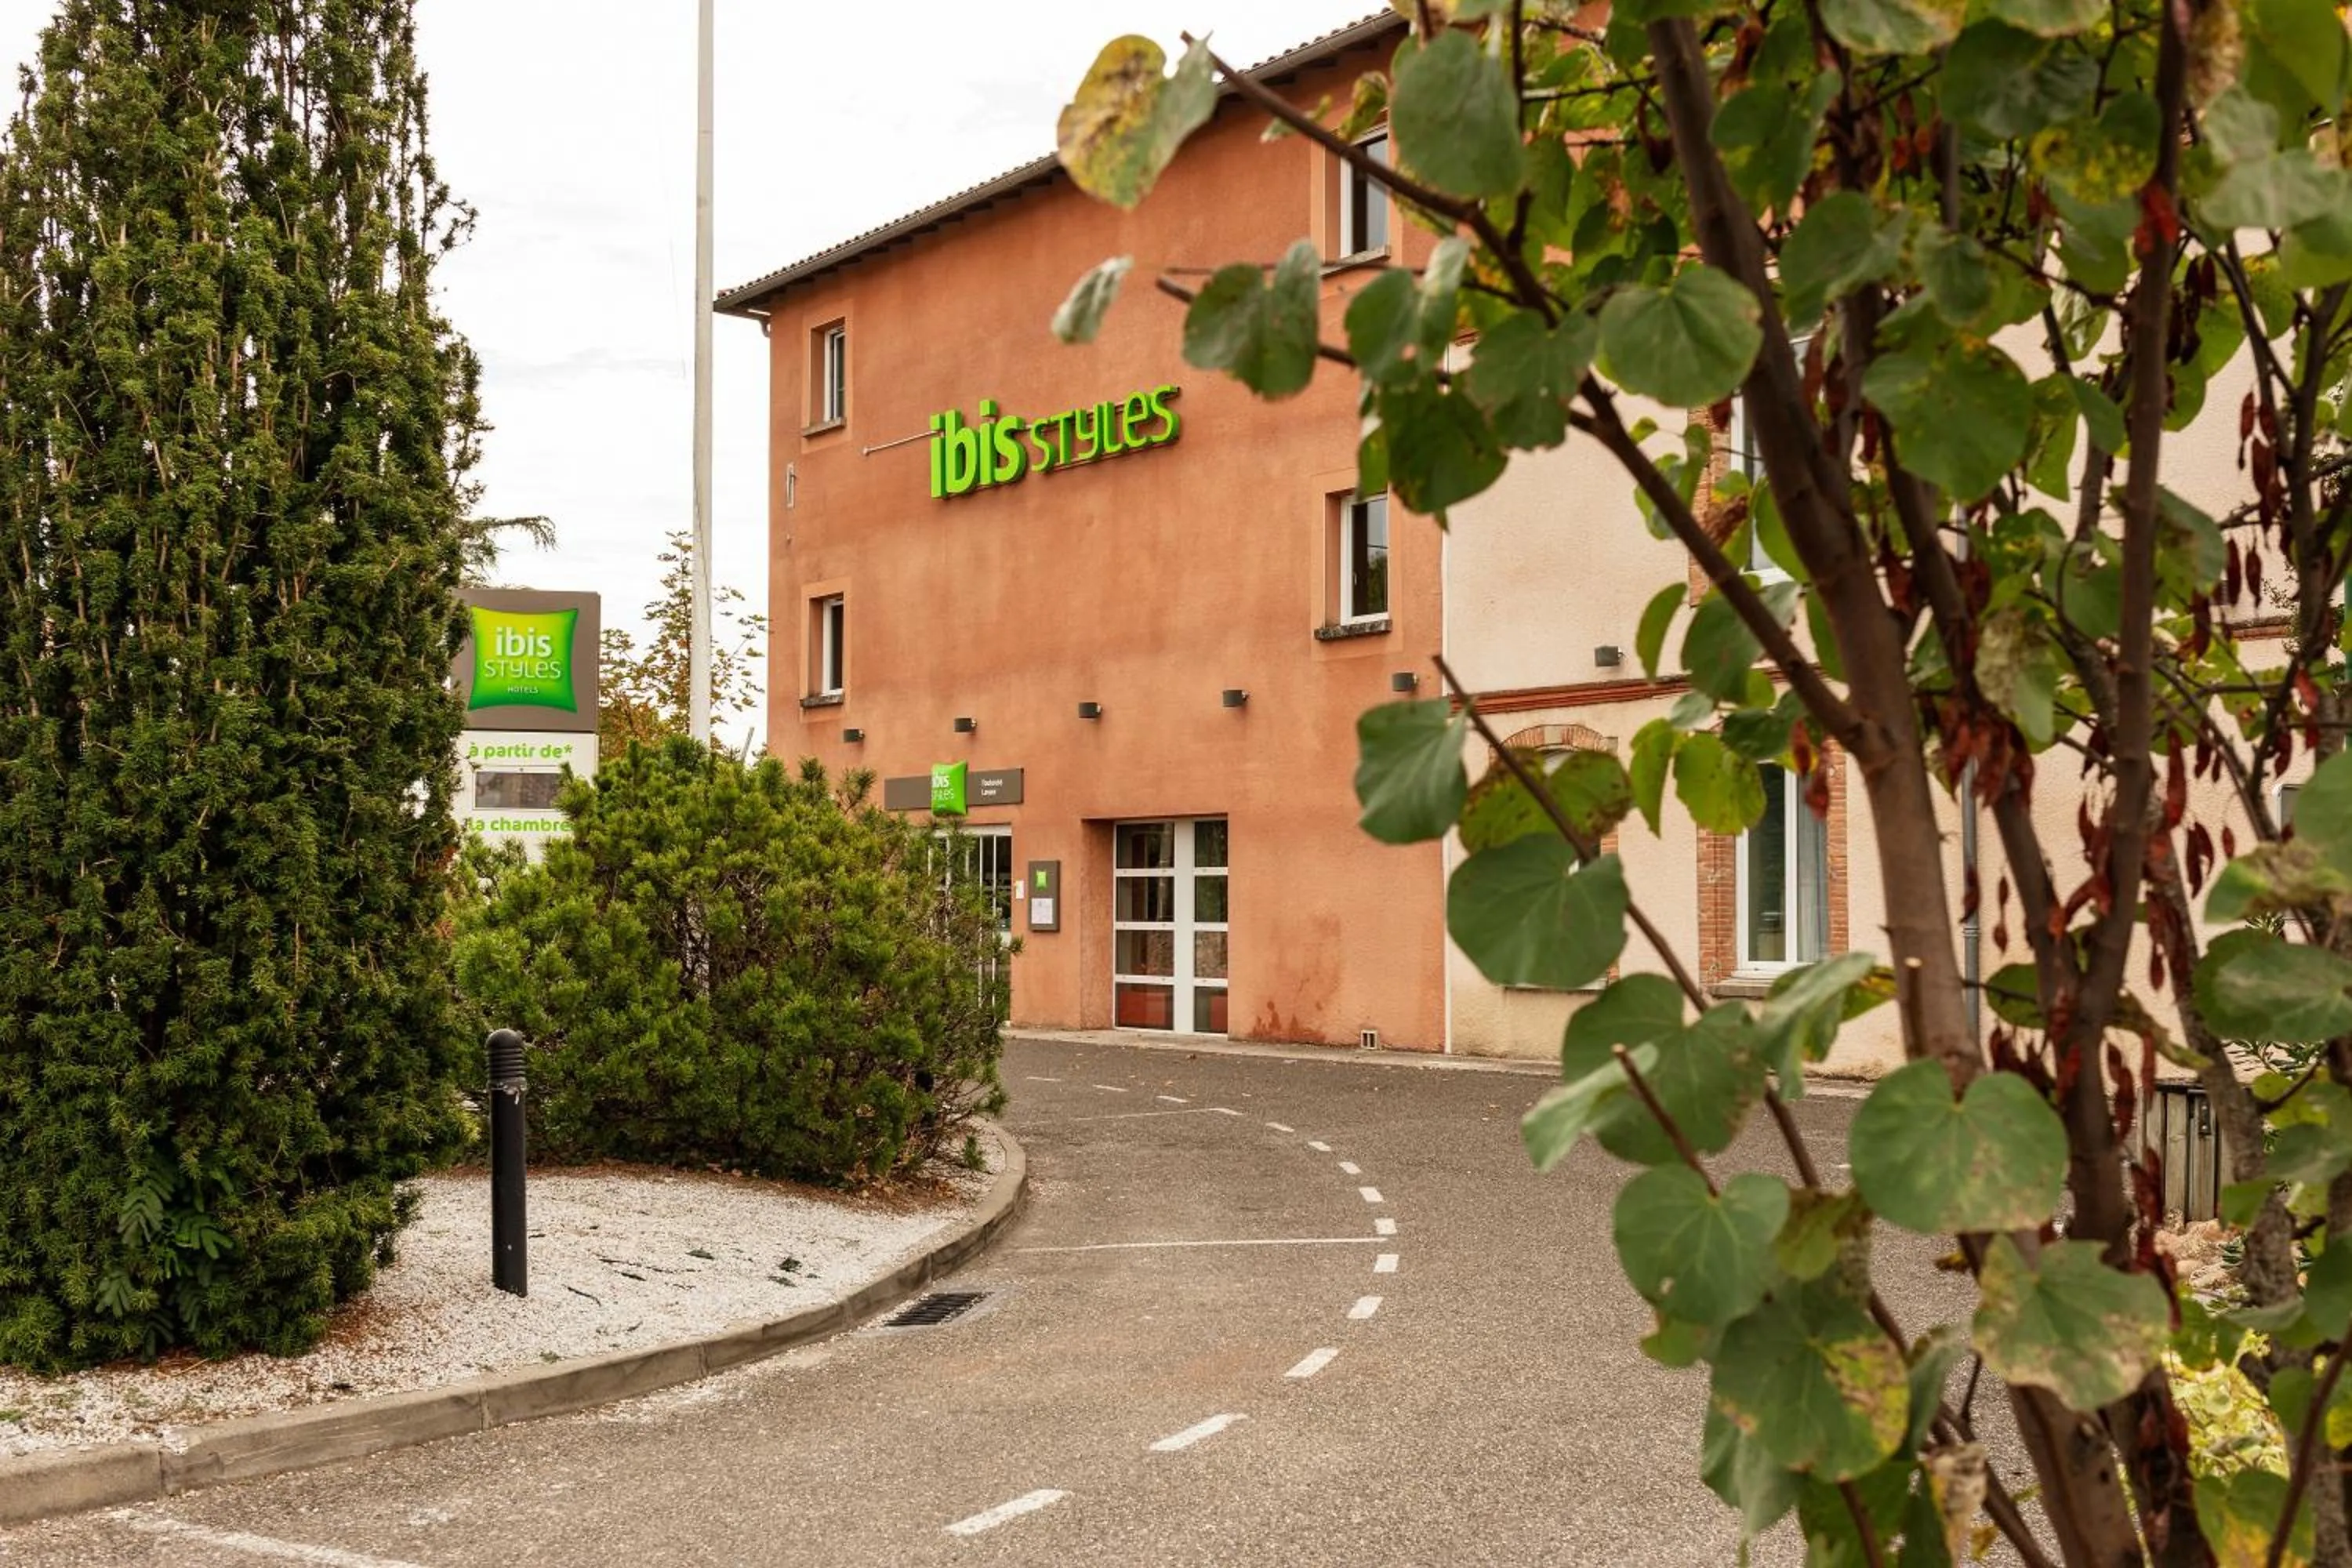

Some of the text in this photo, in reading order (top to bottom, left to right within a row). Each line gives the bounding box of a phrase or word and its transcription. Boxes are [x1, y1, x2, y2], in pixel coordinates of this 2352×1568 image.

[930, 399, 1027, 499] ibis
[495, 626, 552, 657] ibis
[469, 741, 479, 757] à
[484, 743, 535, 759] partir
[490, 817, 572, 832] chambre
